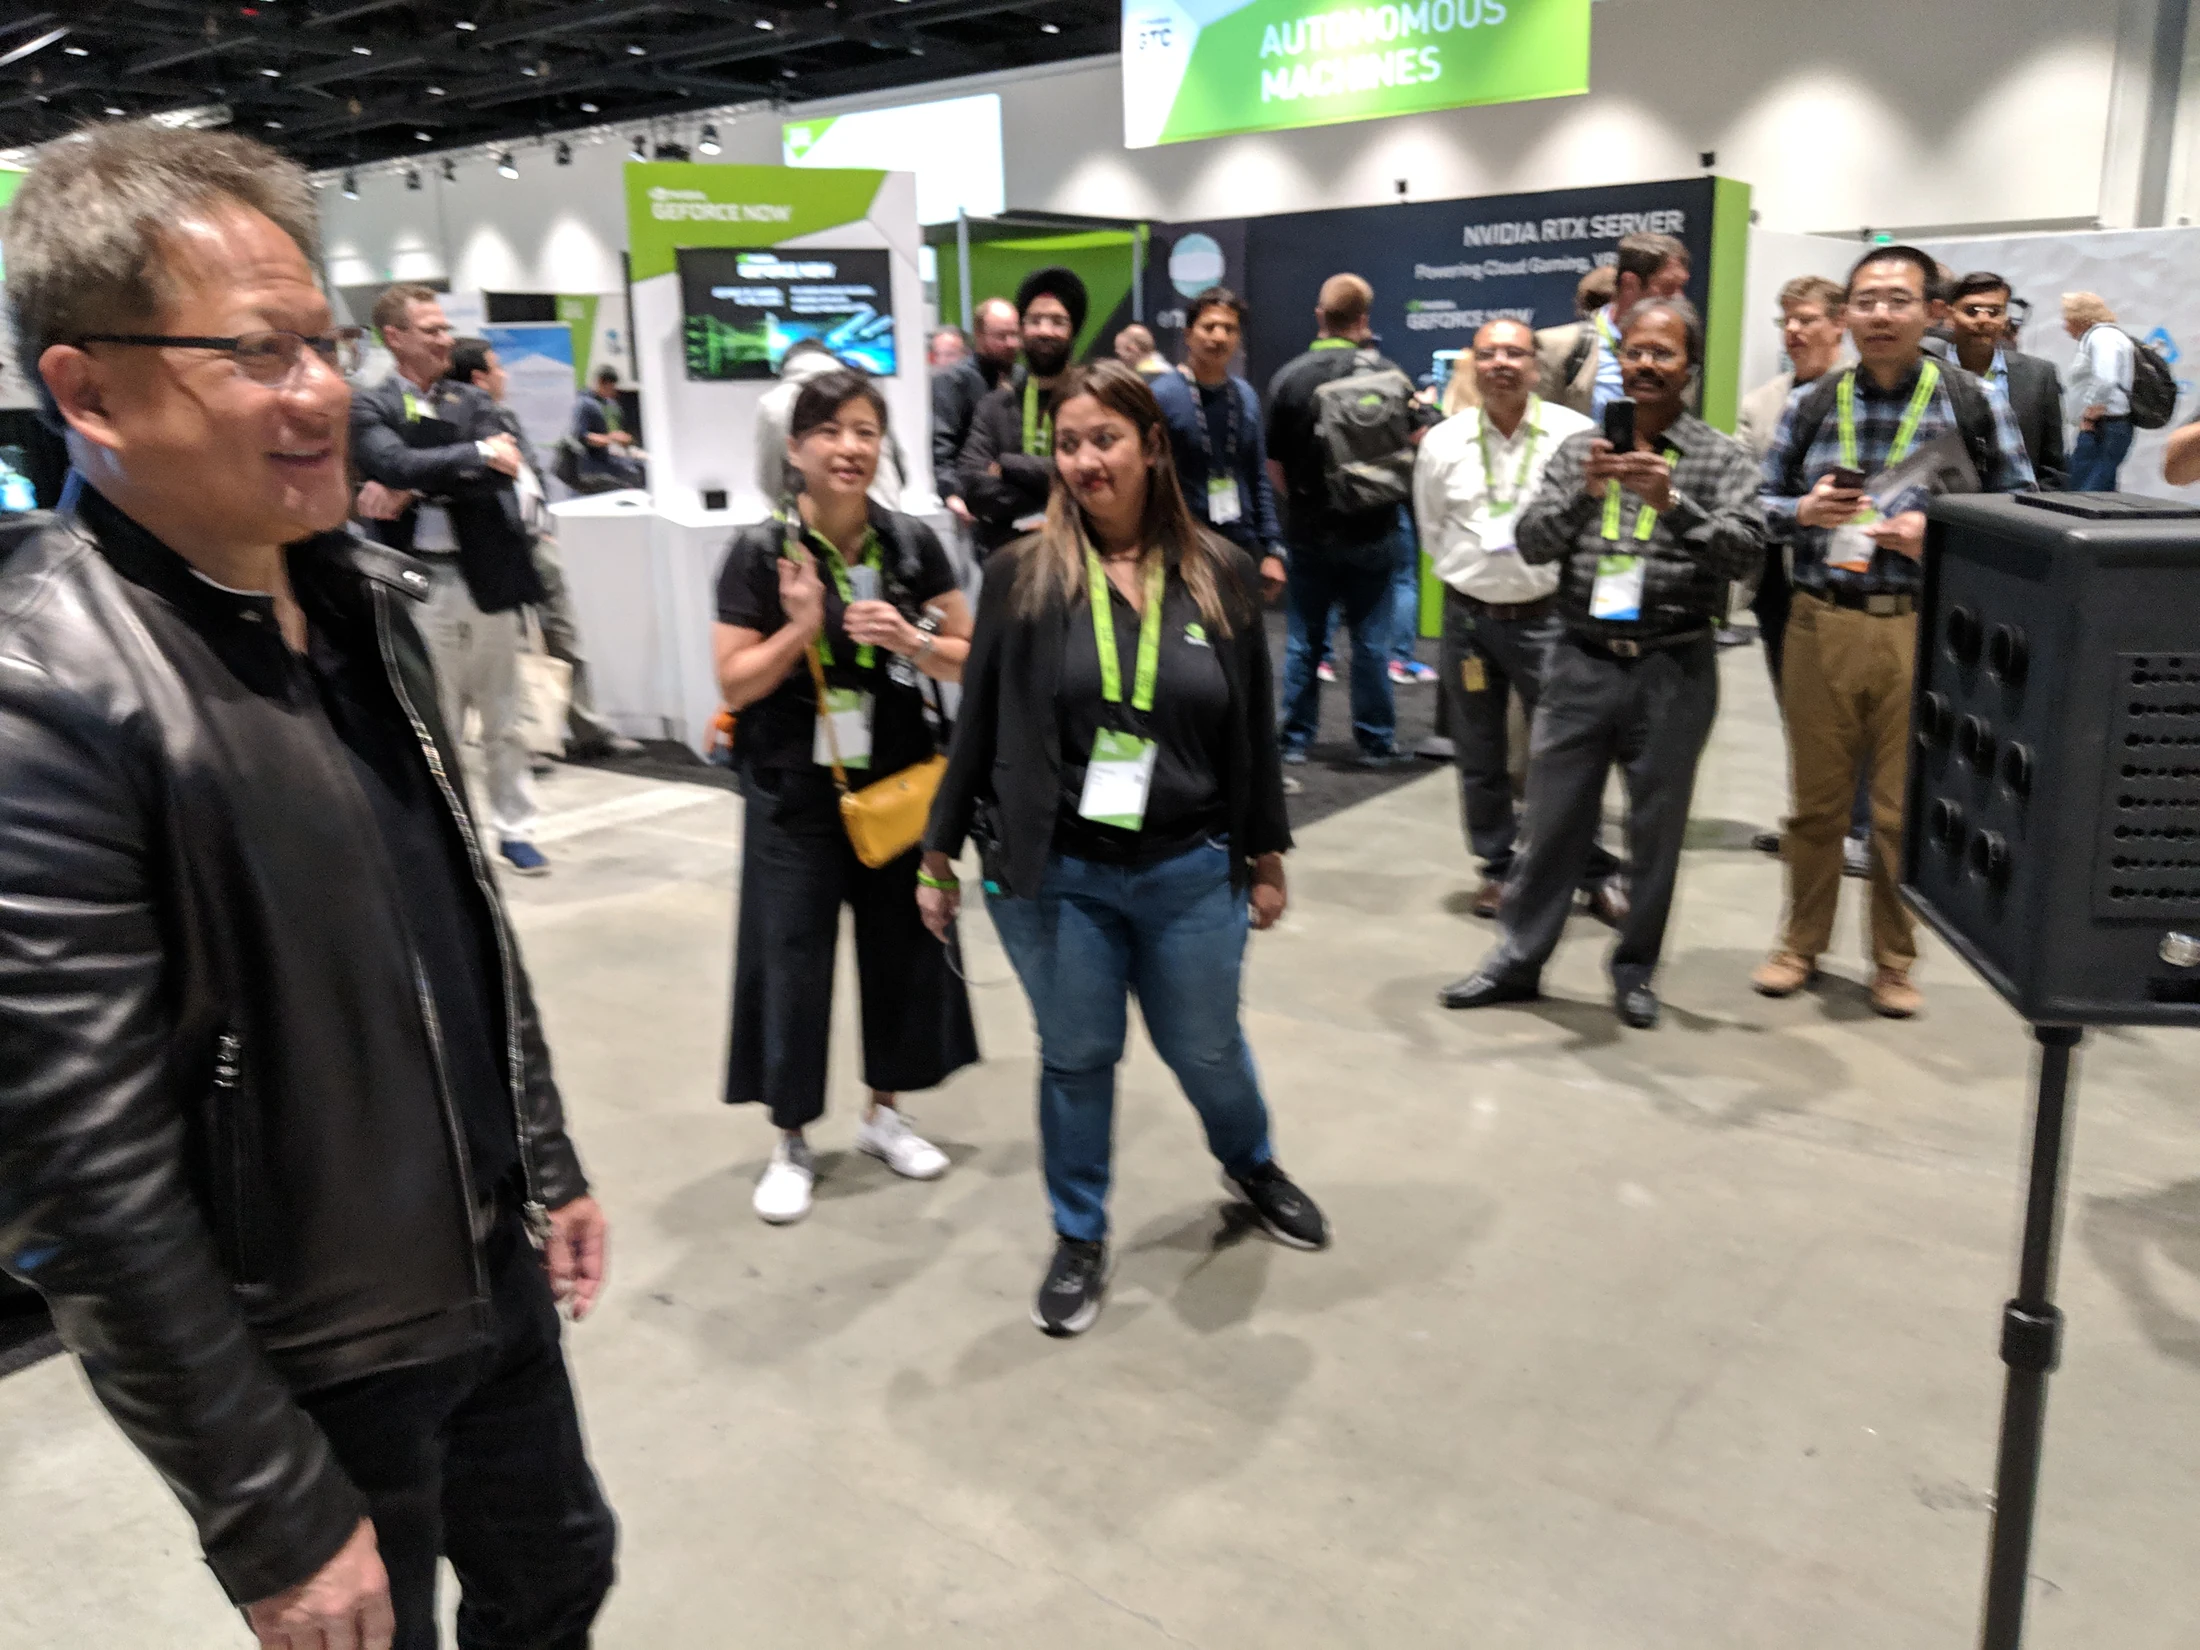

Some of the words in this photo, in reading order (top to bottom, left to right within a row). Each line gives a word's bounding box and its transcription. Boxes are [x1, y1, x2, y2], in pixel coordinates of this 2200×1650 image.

[1259, 0, 1507, 58] AUTONOMOUS
[1260, 46, 1442, 102] MACHINES
[650, 202, 740, 221] GEFORCE
[743, 203, 792, 222] NOW
[1463, 217, 1540, 247] NVIDIA
[1541, 212, 1589, 241] RTX
[1590, 209, 1685, 238] SERVER
